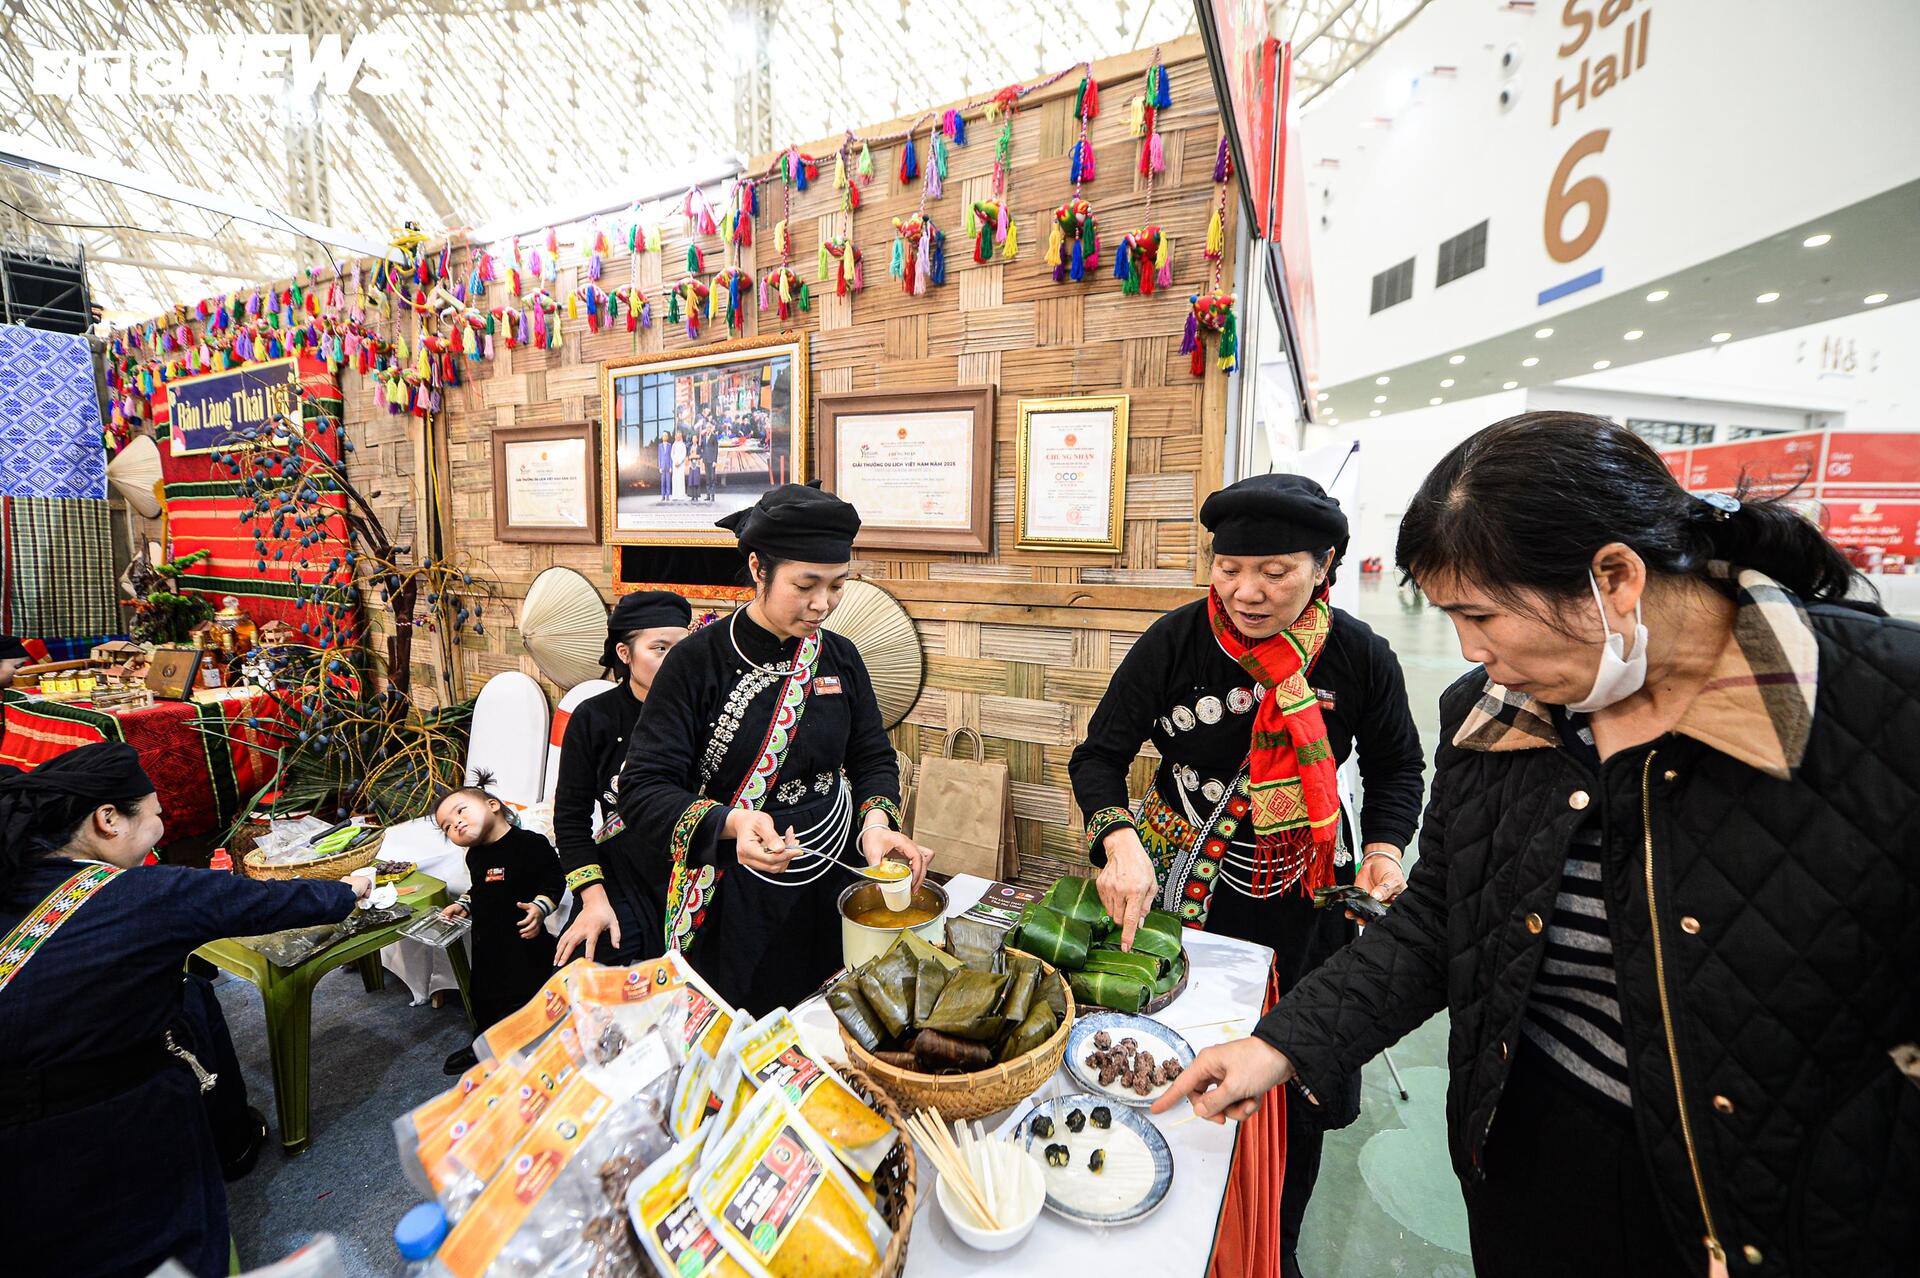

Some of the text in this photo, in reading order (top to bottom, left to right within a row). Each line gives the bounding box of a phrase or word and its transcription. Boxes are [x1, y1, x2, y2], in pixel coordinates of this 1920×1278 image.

[1551, 7, 1652, 127] Hall
[1543, 128, 1612, 264] 6
[177, 400, 201, 431] Bản
[201, 397, 233, 431] Làng
[232, 388, 265, 423] Thái
